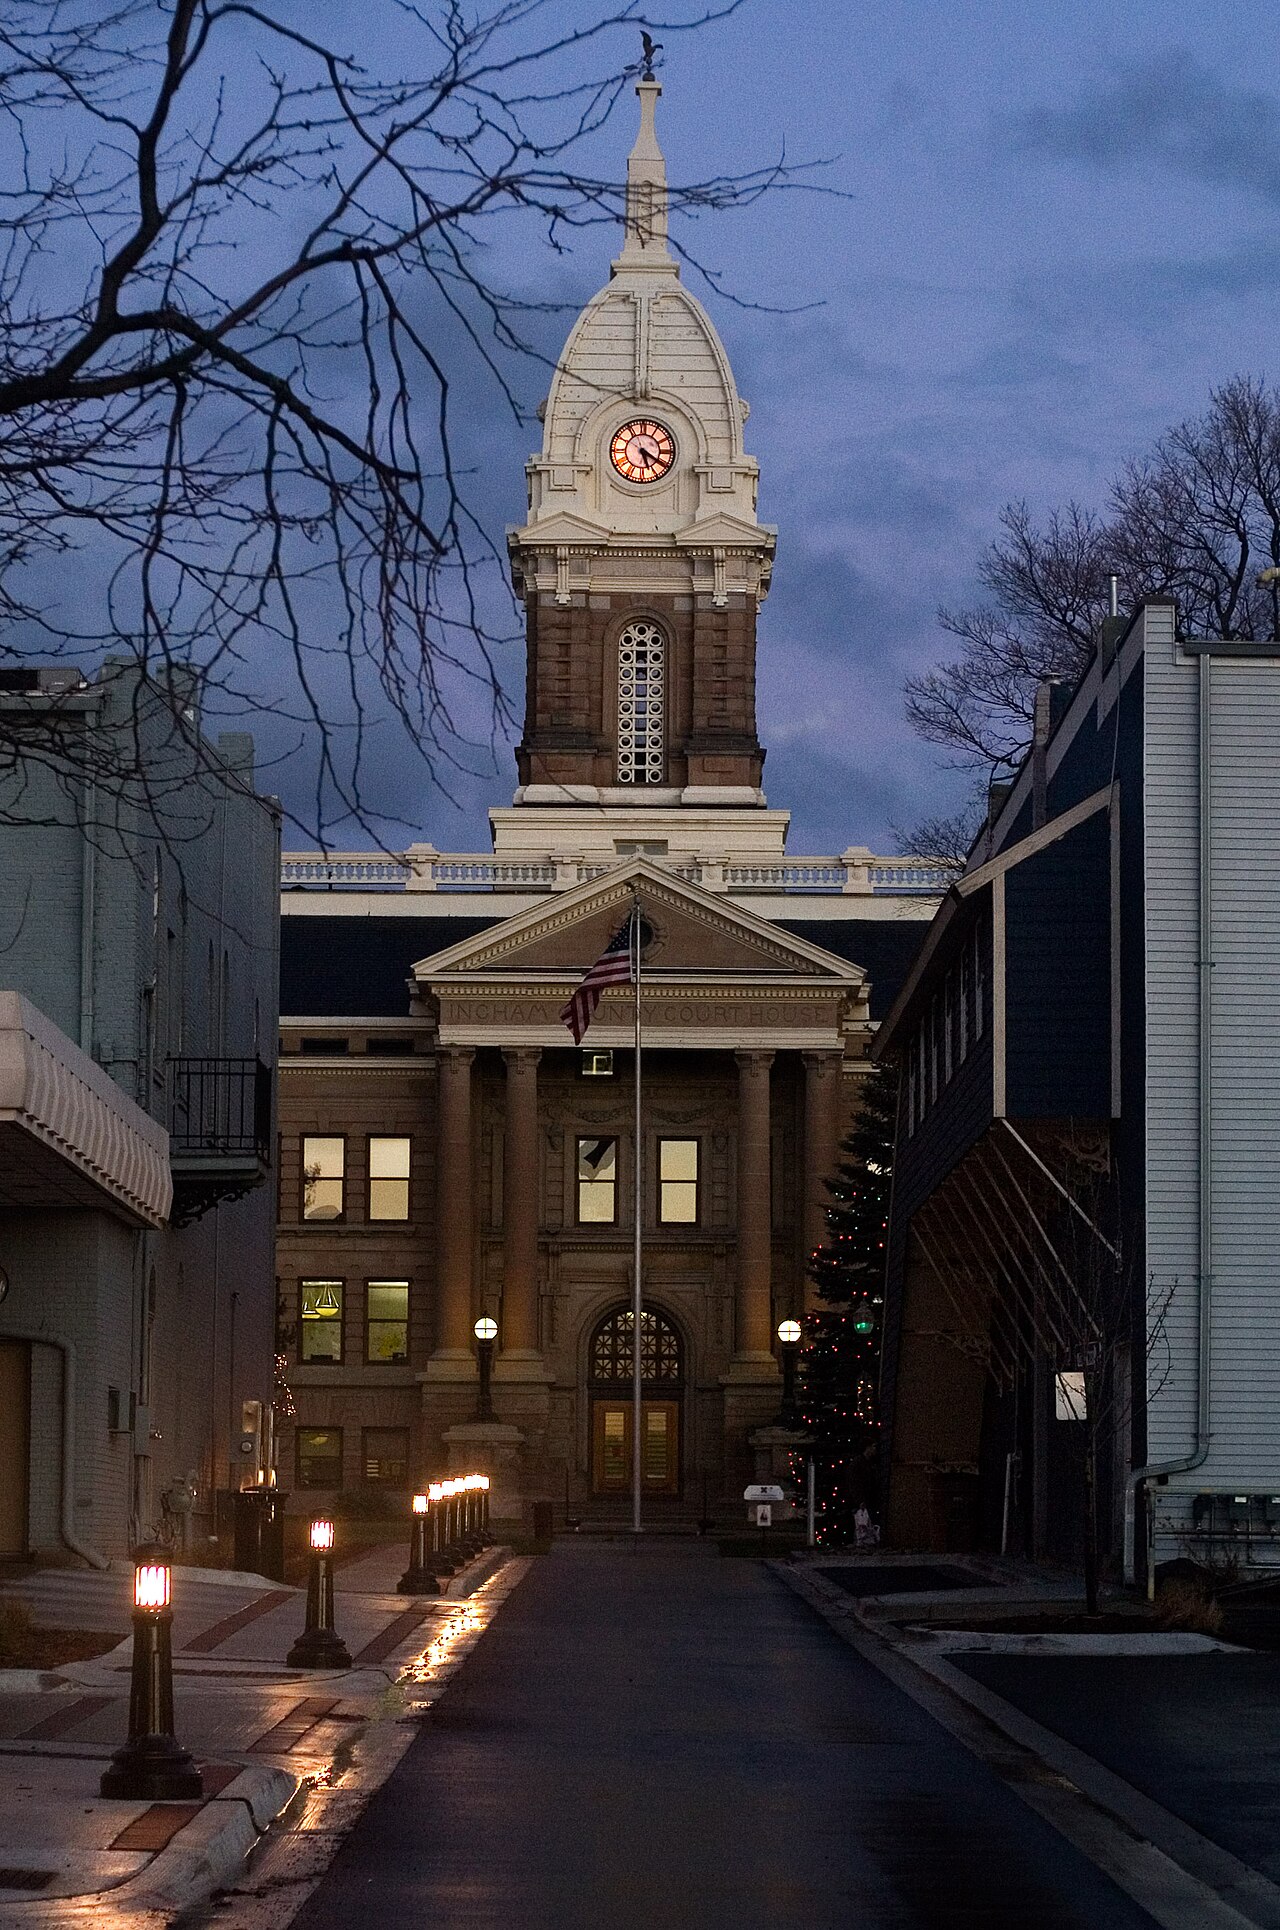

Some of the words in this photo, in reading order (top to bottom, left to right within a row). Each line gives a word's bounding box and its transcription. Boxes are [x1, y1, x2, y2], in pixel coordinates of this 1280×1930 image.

[450, 1003, 548, 1021] INGHAM
[559, 1004, 657, 1022] UNTY
[664, 1006, 743, 1023] COURT
[751, 1007, 828, 1024] HOUSE
